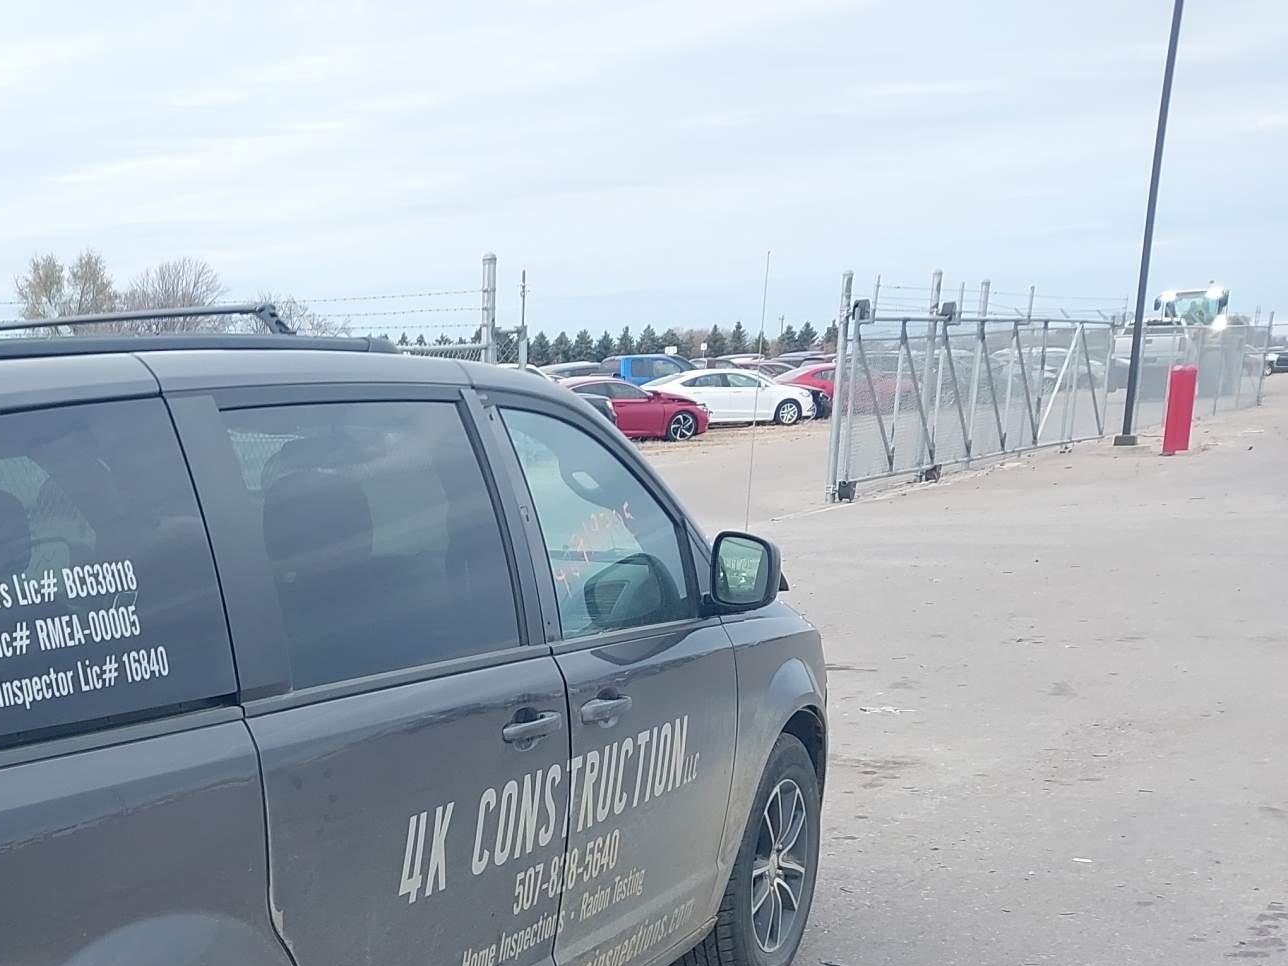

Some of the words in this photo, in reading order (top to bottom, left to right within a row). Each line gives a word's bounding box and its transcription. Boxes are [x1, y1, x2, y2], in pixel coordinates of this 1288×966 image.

[13, 569, 57, 606] Lic#
[62, 560, 137, 599] BC638118
[35, 605, 141, 651] RMEA-00005
[77, 654, 119, 692] Lic#
[122, 646, 169, 683] 16840
[398, 801, 455, 904] 4K
[472, 715, 689, 875] CONSTRUCTION
[513, 828, 620, 915] 507-828-5640
[498, 910, 565, 964] Inspections
[580, 885, 611, 921] Radon
[612, 867, 646, 905] Testing
